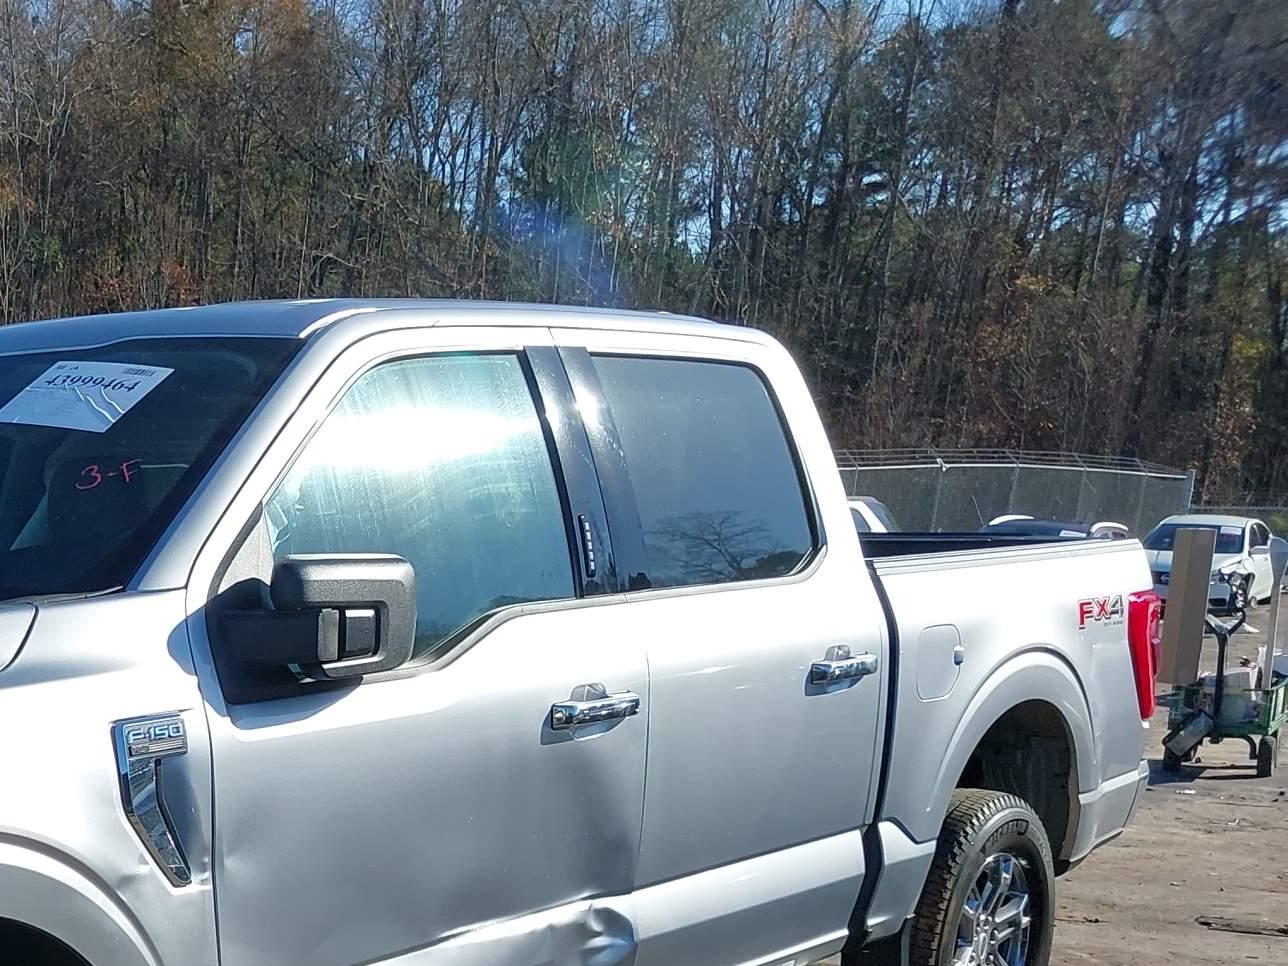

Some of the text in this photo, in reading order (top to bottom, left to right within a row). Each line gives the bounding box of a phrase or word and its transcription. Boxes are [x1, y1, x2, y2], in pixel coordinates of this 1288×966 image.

[45, 374, 142, 392] 43999464
[75, 459, 142, 489] 3-F
[1078, 594, 1124, 630] FX4
[128, 723, 184, 744] F-150
